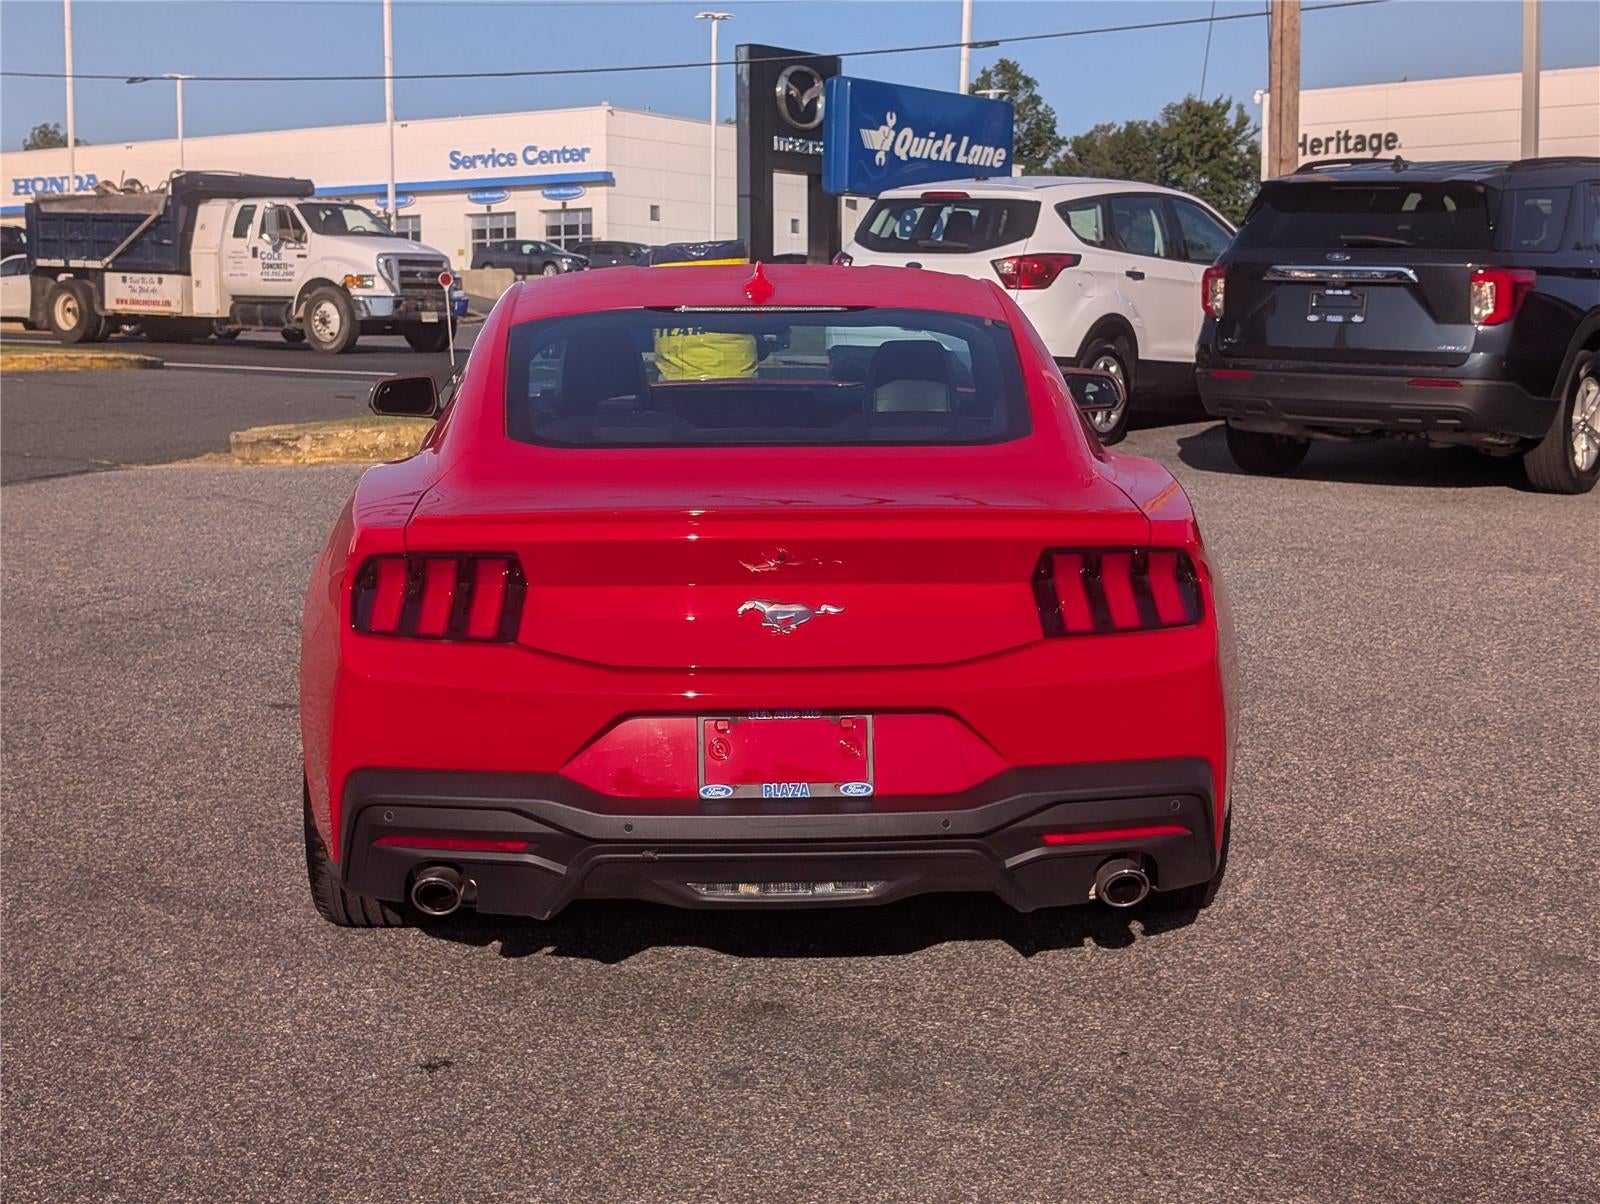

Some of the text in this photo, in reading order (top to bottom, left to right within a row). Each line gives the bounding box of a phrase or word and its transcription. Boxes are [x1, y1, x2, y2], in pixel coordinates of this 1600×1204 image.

[449, 145, 591, 170] Service Center
[894, 126, 1007, 169] Quick Lane
[12, 173, 98, 196] HONDA
[704, 782, 869, 798] Ford PLAZA Ford
